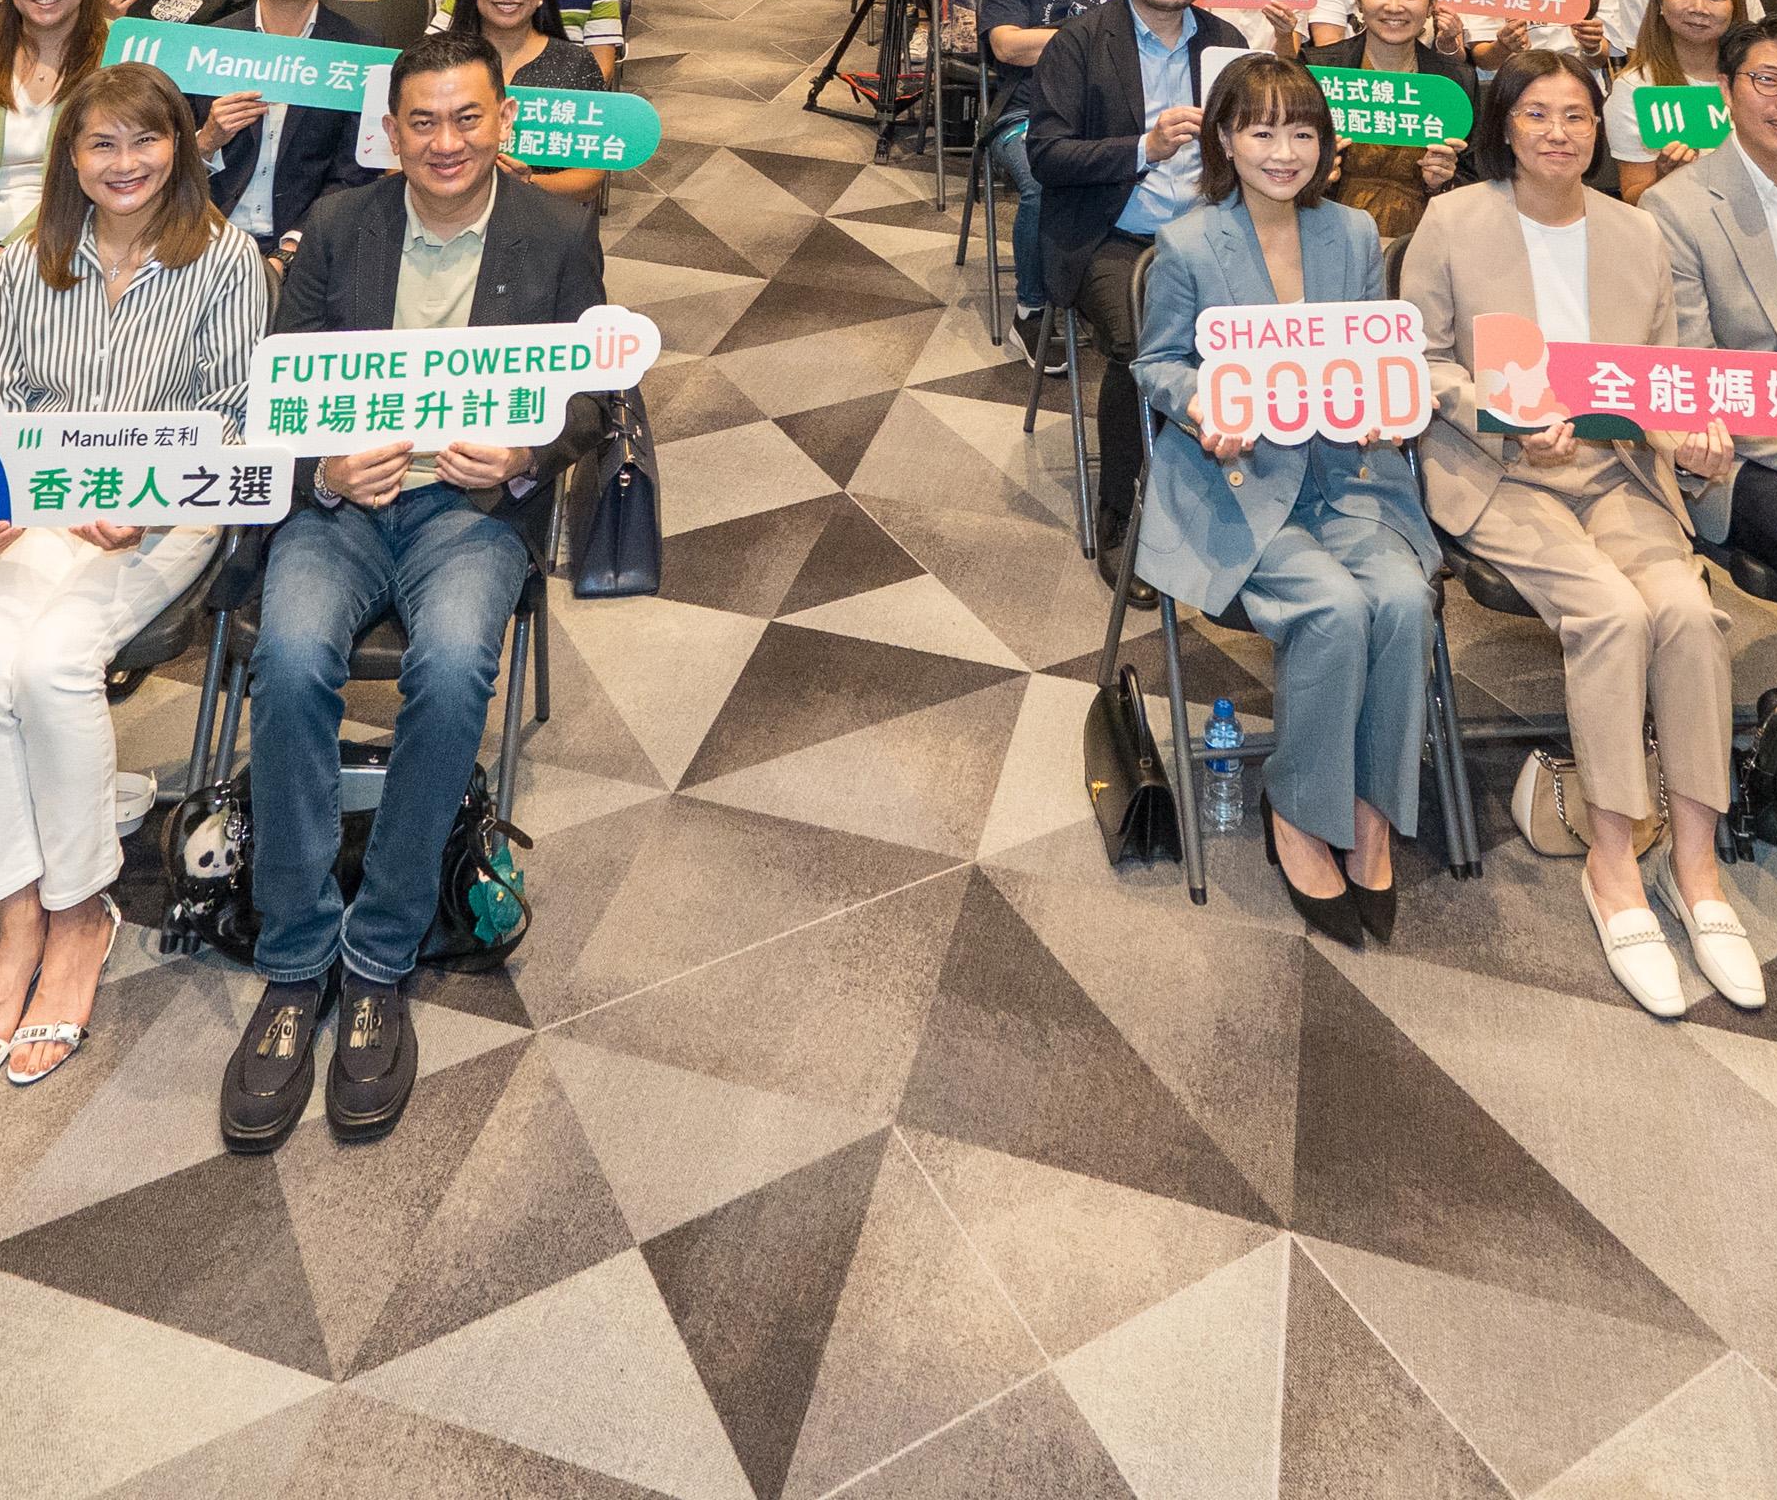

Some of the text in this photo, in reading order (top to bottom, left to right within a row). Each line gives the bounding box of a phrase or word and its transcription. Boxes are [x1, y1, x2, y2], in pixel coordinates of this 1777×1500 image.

[186, 46, 368, 93] Manulife 宏
[1320, 76, 1421, 106] 站式線上
[512, 97, 605, 127] 式線上
[1208, 313, 1415, 351] SHARE FOR
[270, 350, 408, 383] FUTURE
[268, 385, 546, 437] 職場提升計劃
[1210, 355, 1421, 435] GOOD
[61, 426, 199, 447] Manulife 宏利
[28, 465, 273, 511] 香港人之選
